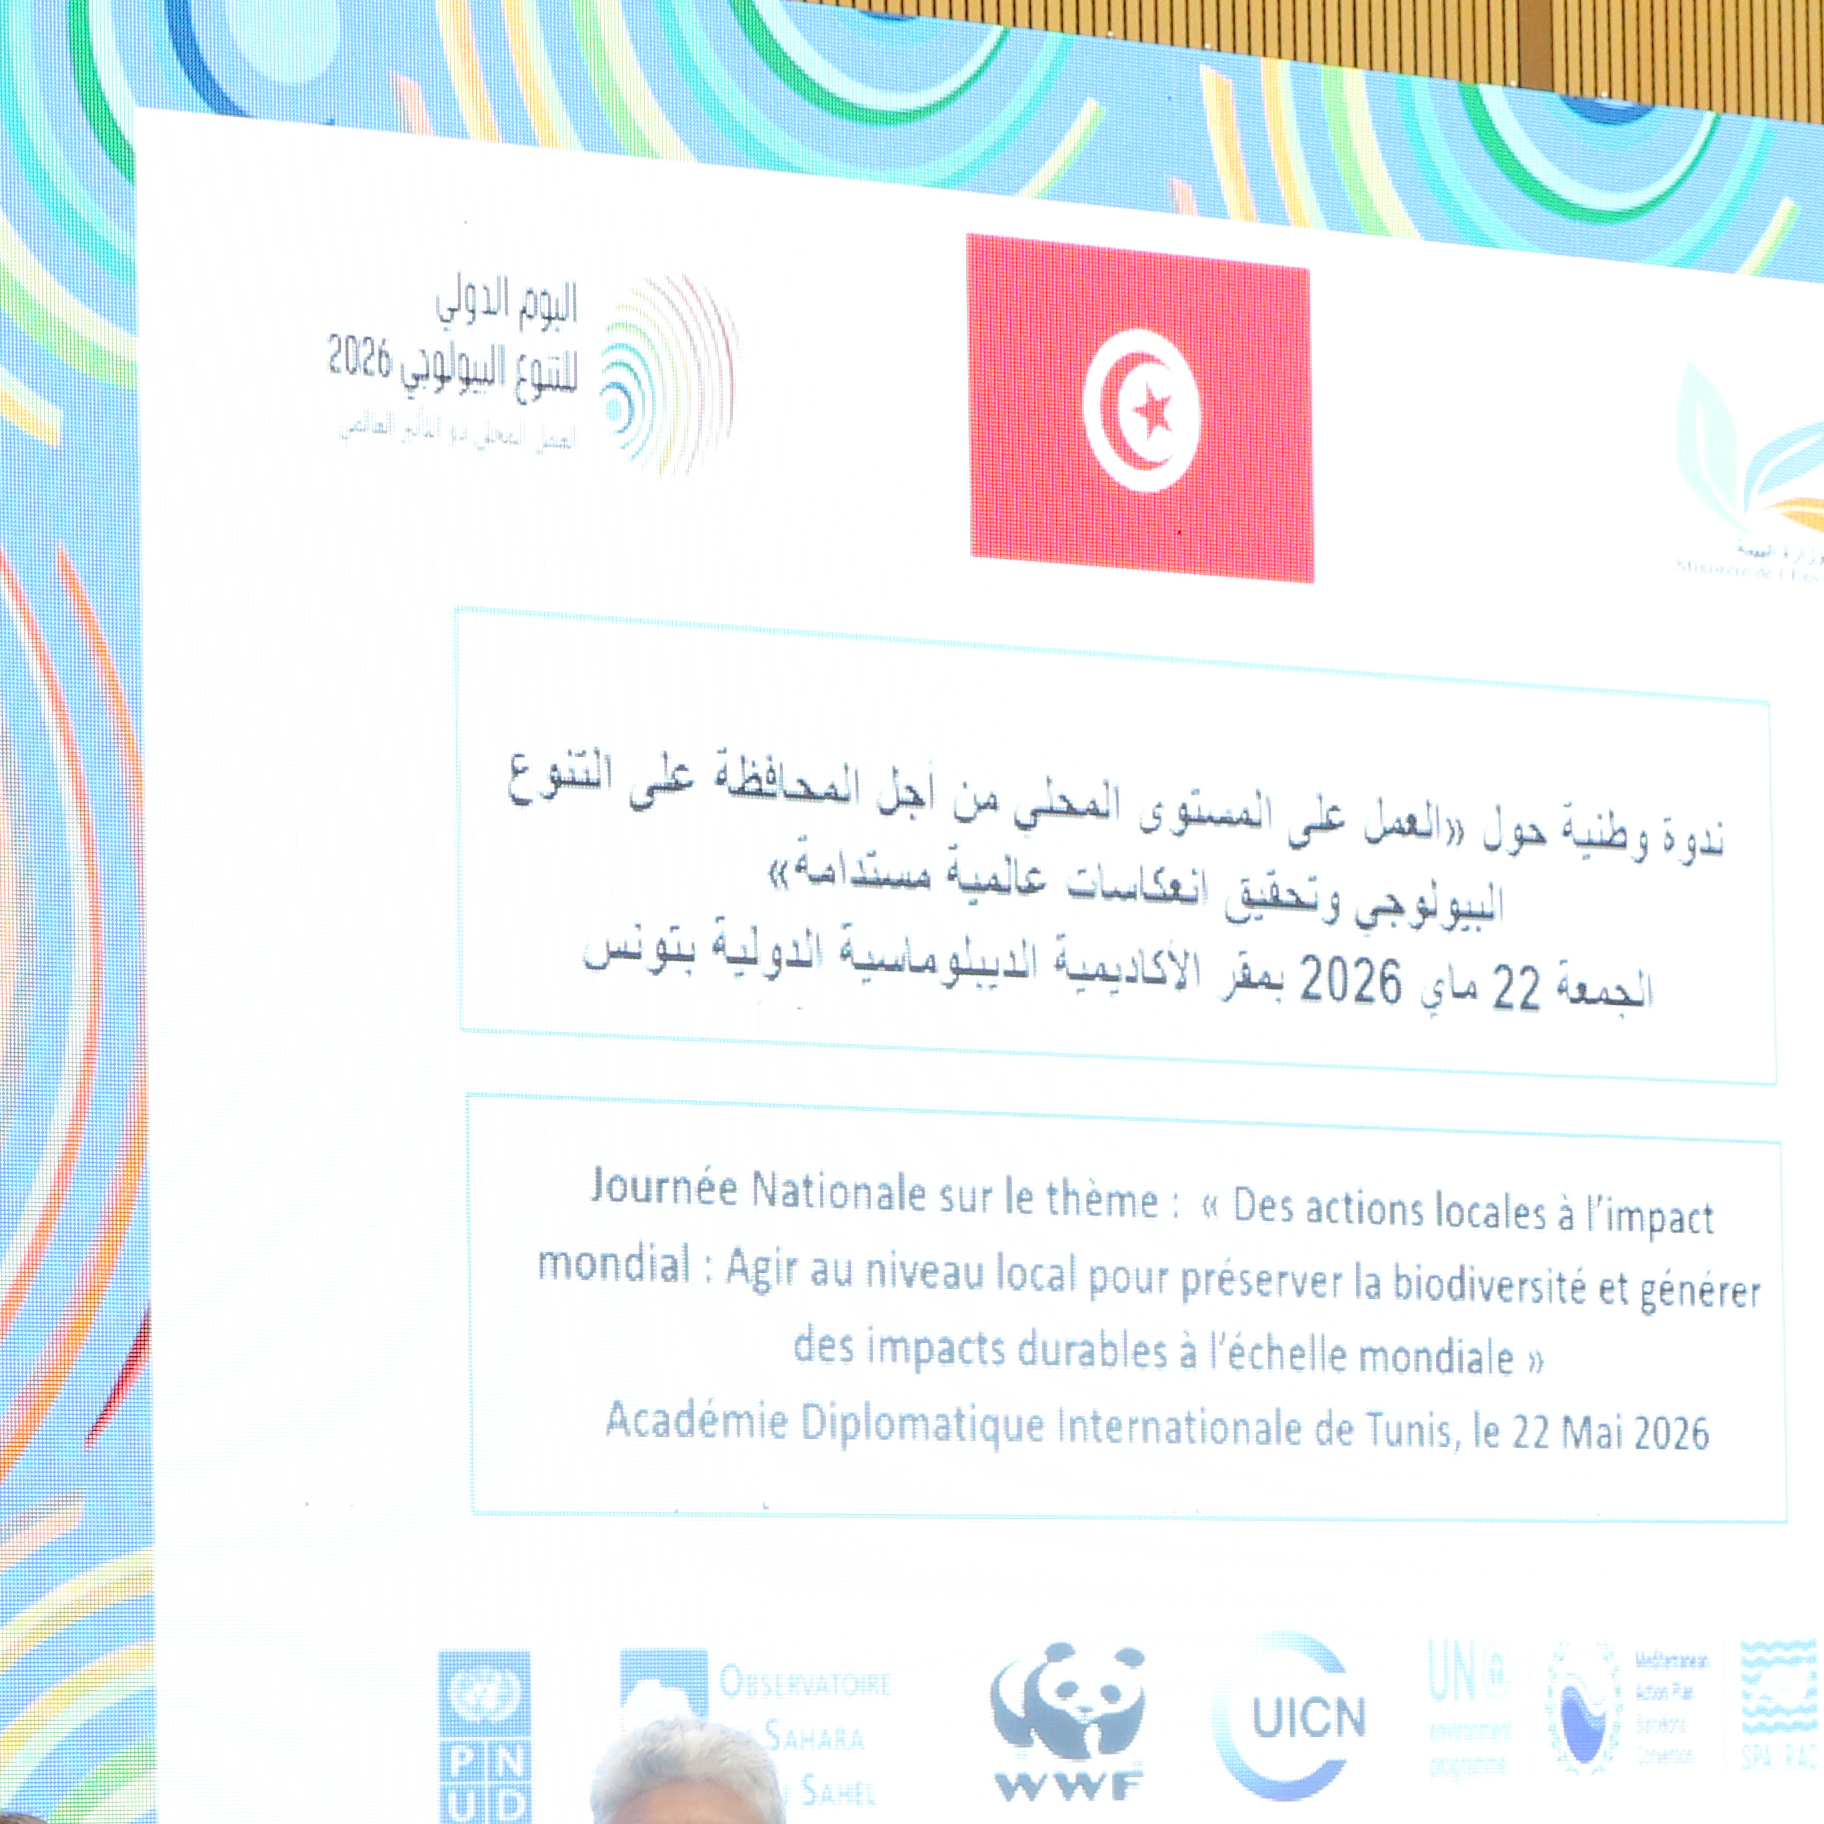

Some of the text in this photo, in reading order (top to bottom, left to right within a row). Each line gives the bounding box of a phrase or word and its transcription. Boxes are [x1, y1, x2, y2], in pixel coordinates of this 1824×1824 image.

[436, 272, 578, 333] اليوم الدولي
[328, 332, 578, 407] للتنوع البيولوجي 2026
[507, 746, 612, 808] التنوع
[628, 750, 695, 813] على
[713, 746, 860, 805] المحافظة
[953, 780, 1000, 825] من
[1139, 787, 1272, 839] المستوى
[1287, 792, 1346, 852] على
[1483, 803, 1548, 858] حول
[1561, 801, 1649, 865] وطنية
[1663, 816, 1725, 868] ندوة
[945, 842, 1047, 907] عالمية
[1066, 863, 1209, 906] انعكاسات
[1224, 868, 1341, 927] وتحقيق
[1353, 877, 1504, 938] البيولوجي
[582, 922, 697, 977] بتونس
[711, 914, 823, 983] الدولية
[1221, 949, 1285, 1004] بمقر
[1299, 953, 1403, 1006] 2026
[1420, 963, 1479, 1019] ماي
[1492, 962, 1541, 1013] 22
[1556, 958, 1653, 1019] الجمعة
[590, 1164, 738, 1206] Journée
[753, 1169, 927, 1212] Nationale
[939, 1184, 994, 1213] sur
[1006, 1174, 1034, 1215] le
[1046, 1176, 1159, 1219] thème
[1234, 1185, 1294, 1223] Des
[1306, 1188, 1425, 1227] actions
[1436, 1188, 1547, 1231] locales
[1557, 1193, 1575, 1231] à
[538, 1240, 690, 1283] mondial
[726, 1246, 799, 1297] Agir
[810, 1257, 853, 1287] au
[867, 1249, 984, 1291] niveau
[997, 1250, 1076, 1293] local
[1089, 1265, 1170, 1302] pour
[1181, 1257, 1343, 1304] préserver
[1355, 1260, 1382, 1300] la
[1394, 1261, 1587, 1305] biodiversité
[1598, 1272, 1629, 1306] et
[1640, 1267, 1762, 1317] générer
[794, 1322, 854, 1363] des
[868, 1325, 1006, 1375] impacts
[1018, 1327, 1168, 1369] durables
[1180, 1330, 1197, 1369] à
[1359, 1335, 1514, 1377] mondiale
[606, 1397, 1710, 1452] Académie Diplomatique Internationale de Tunis, le 22 Mai 2026
[1427, 1638, 1476, 1703] UN
[1253, 1695, 1367, 1739] UICN
[993, 1769, 1145, 1803] WWF
